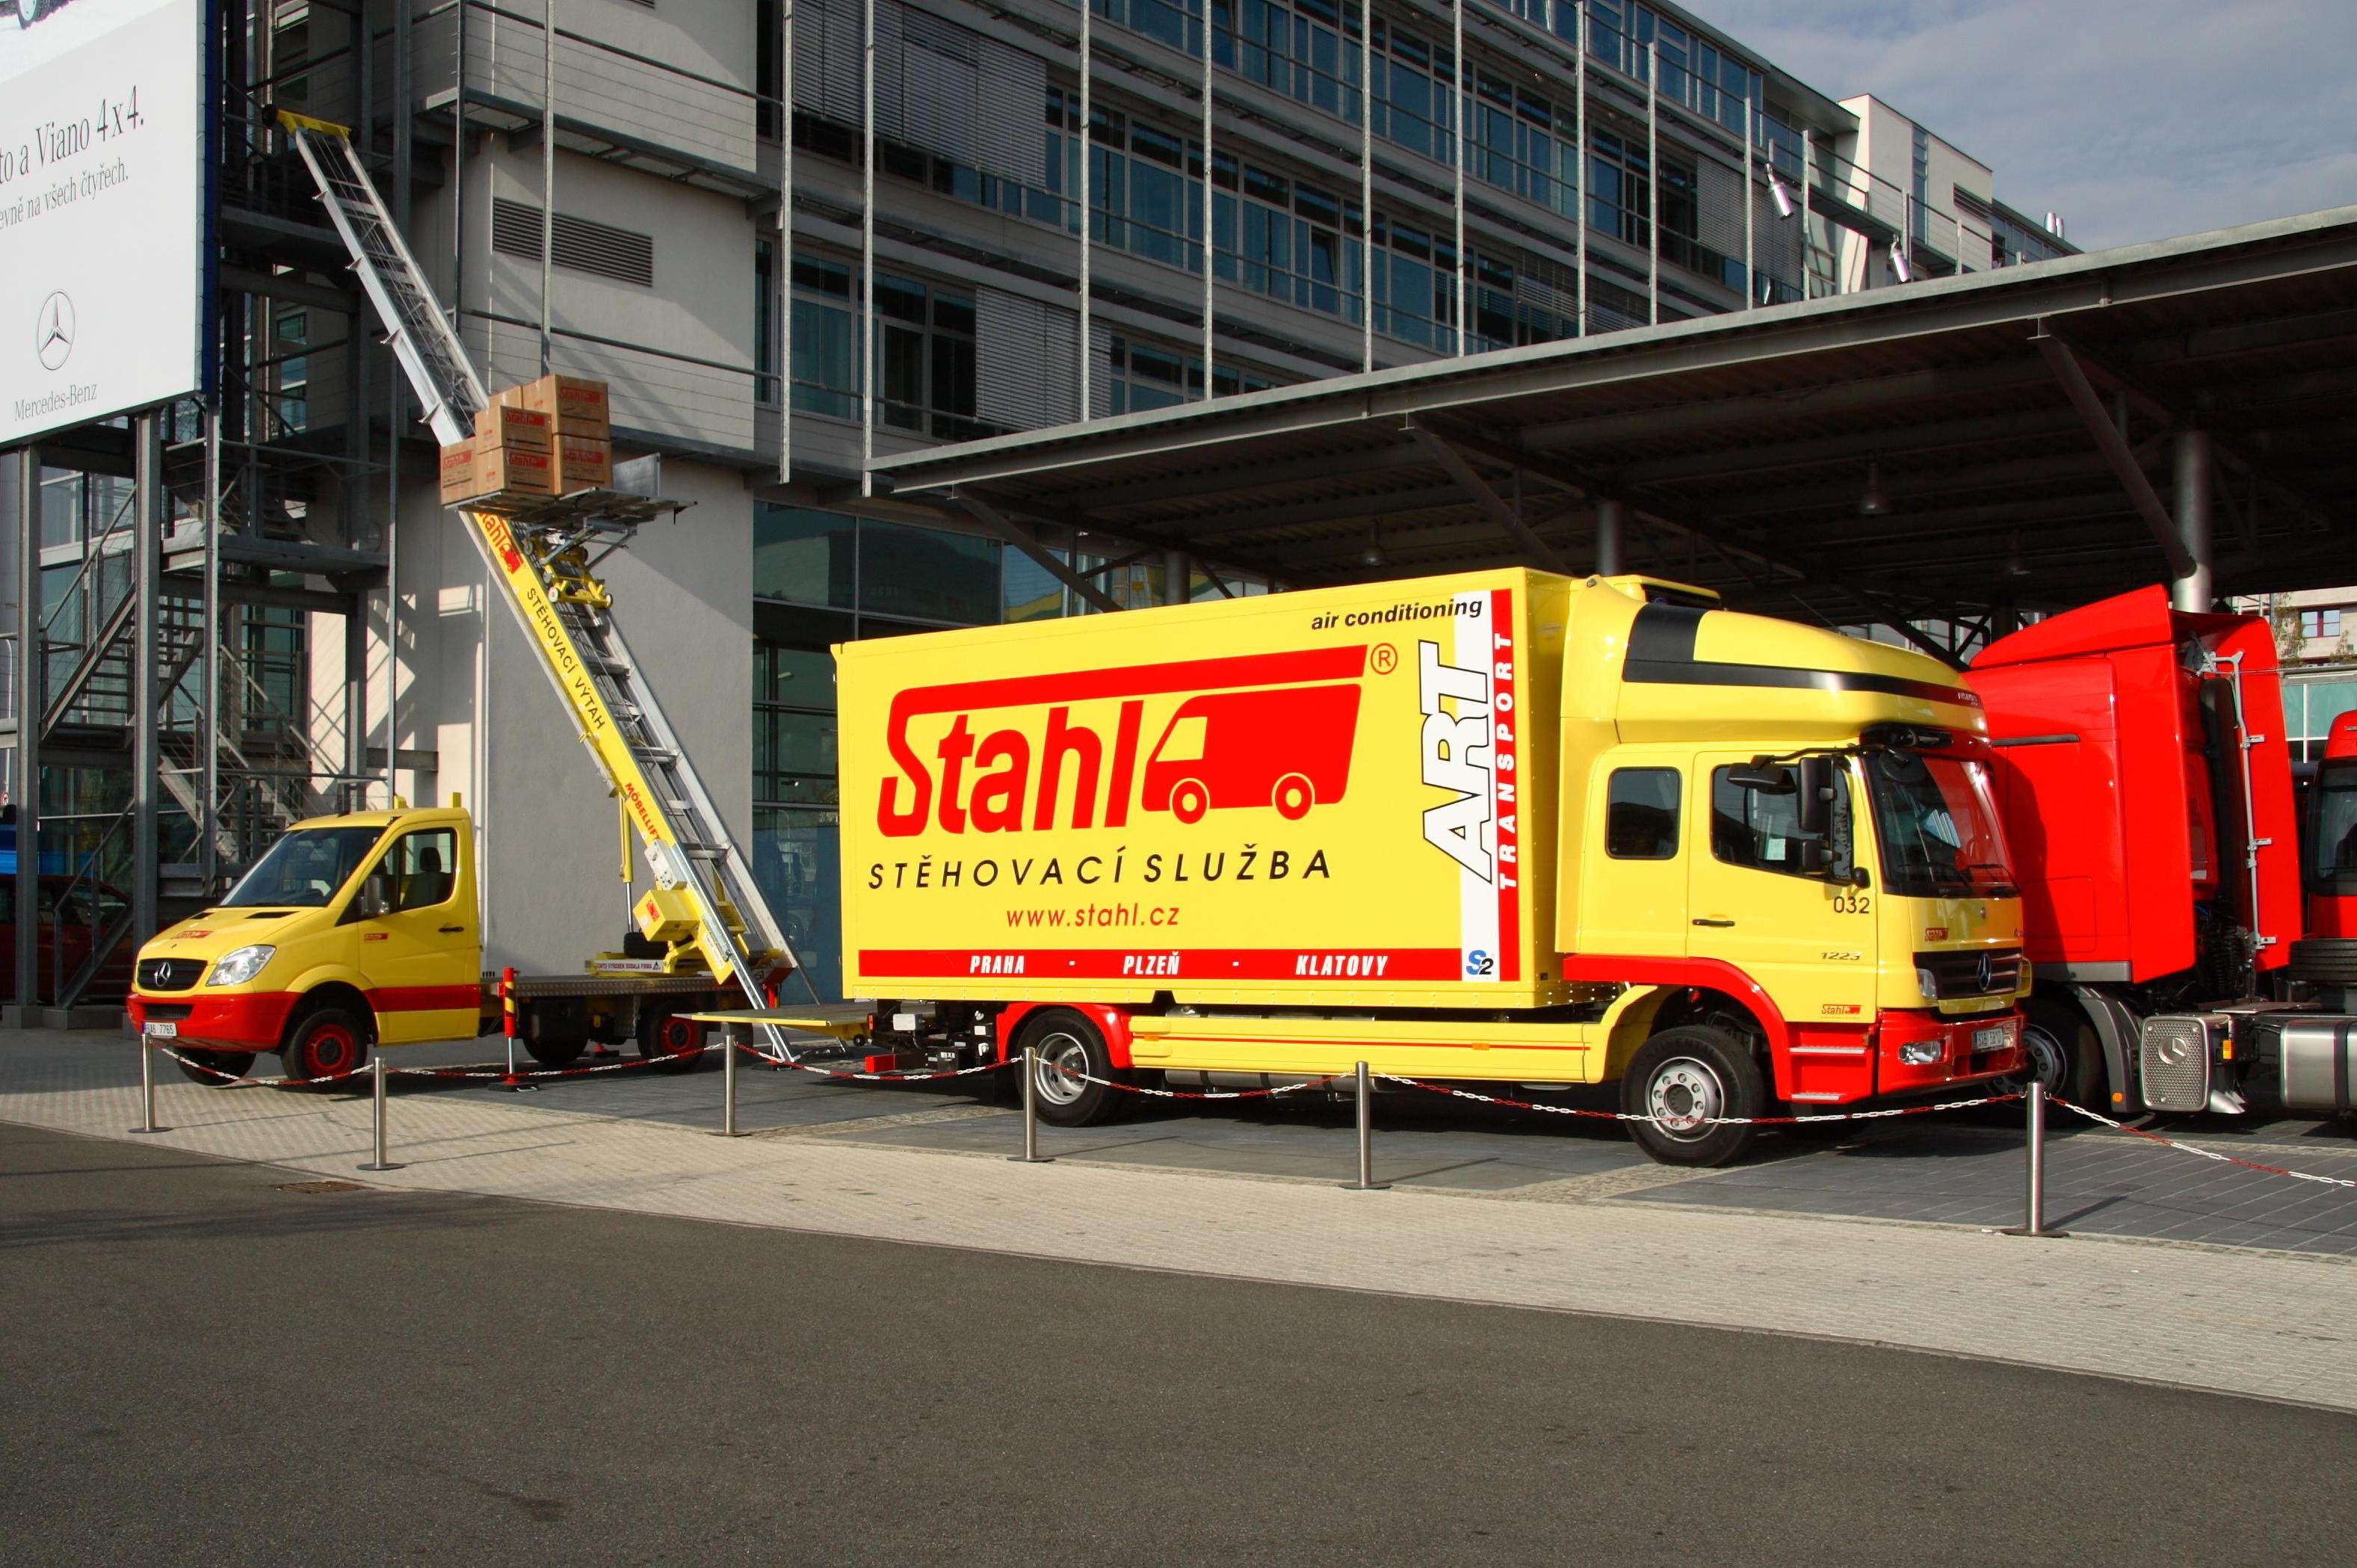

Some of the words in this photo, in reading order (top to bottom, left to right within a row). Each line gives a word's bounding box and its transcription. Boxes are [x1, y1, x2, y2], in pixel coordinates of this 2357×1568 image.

[19, 145, 30, 176] a
[36, 117, 90, 168] Viano
[27, 196, 40, 219] na
[44, 176, 77, 212] všech
[81, 157, 129, 200] čtyřech.
[14, 383, 98, 422] Mercedes-Benz
[1311, 611, 1340, 630] air
[1344, 598, 1483, 627] conditioning
[527, 587, 577, 674] STĚHOVACÍ
[575, 676, 606, 730] VÝTAH
[876, 676, 1145, 838] Stahl
[1418, 639, 1493, 885] ART
[1494, 633, 1517, 890] TRANSPORT
[625, 783, 661, 842] MÖBELLIFT
[868, 845, 1126, 890] STĚHOVACÍ
[1144, 843, 1330, 883] SLUŽBA
[1006, 902, 1180, 928] www.stahl.cz
[1833, 896, 1871, 914] 032
[969, 955, 1025, 975] PRAHA
[1123, 951, 1180, 975] PLZEŇ
[1295, 955, 1388, 976] KLATOVY
[1465, 949, 1494, 975] S2
[1820, 951, 1862, 961] 1223
